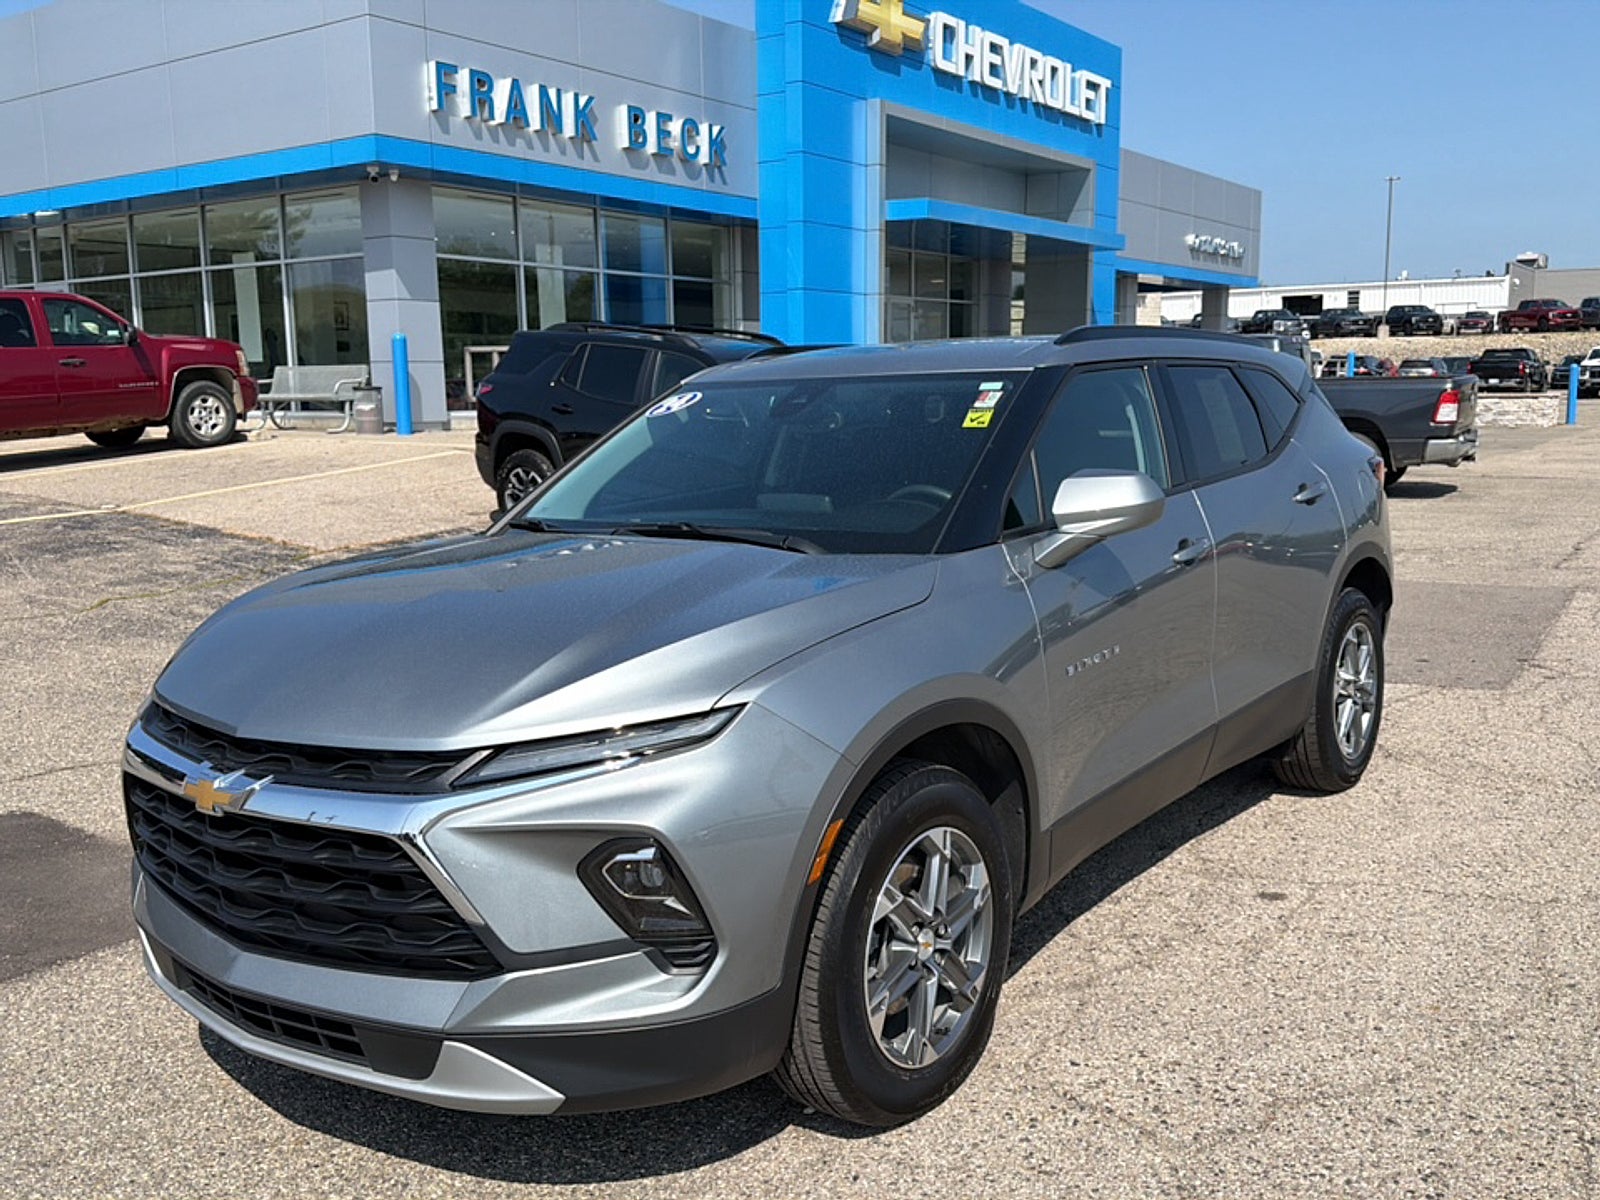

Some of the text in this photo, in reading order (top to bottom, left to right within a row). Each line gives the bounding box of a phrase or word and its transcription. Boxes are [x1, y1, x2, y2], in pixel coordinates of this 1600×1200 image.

[430, 60, 727, 167] FRANK BECK
[928, 11, 1112, 125] CHEVROLET
